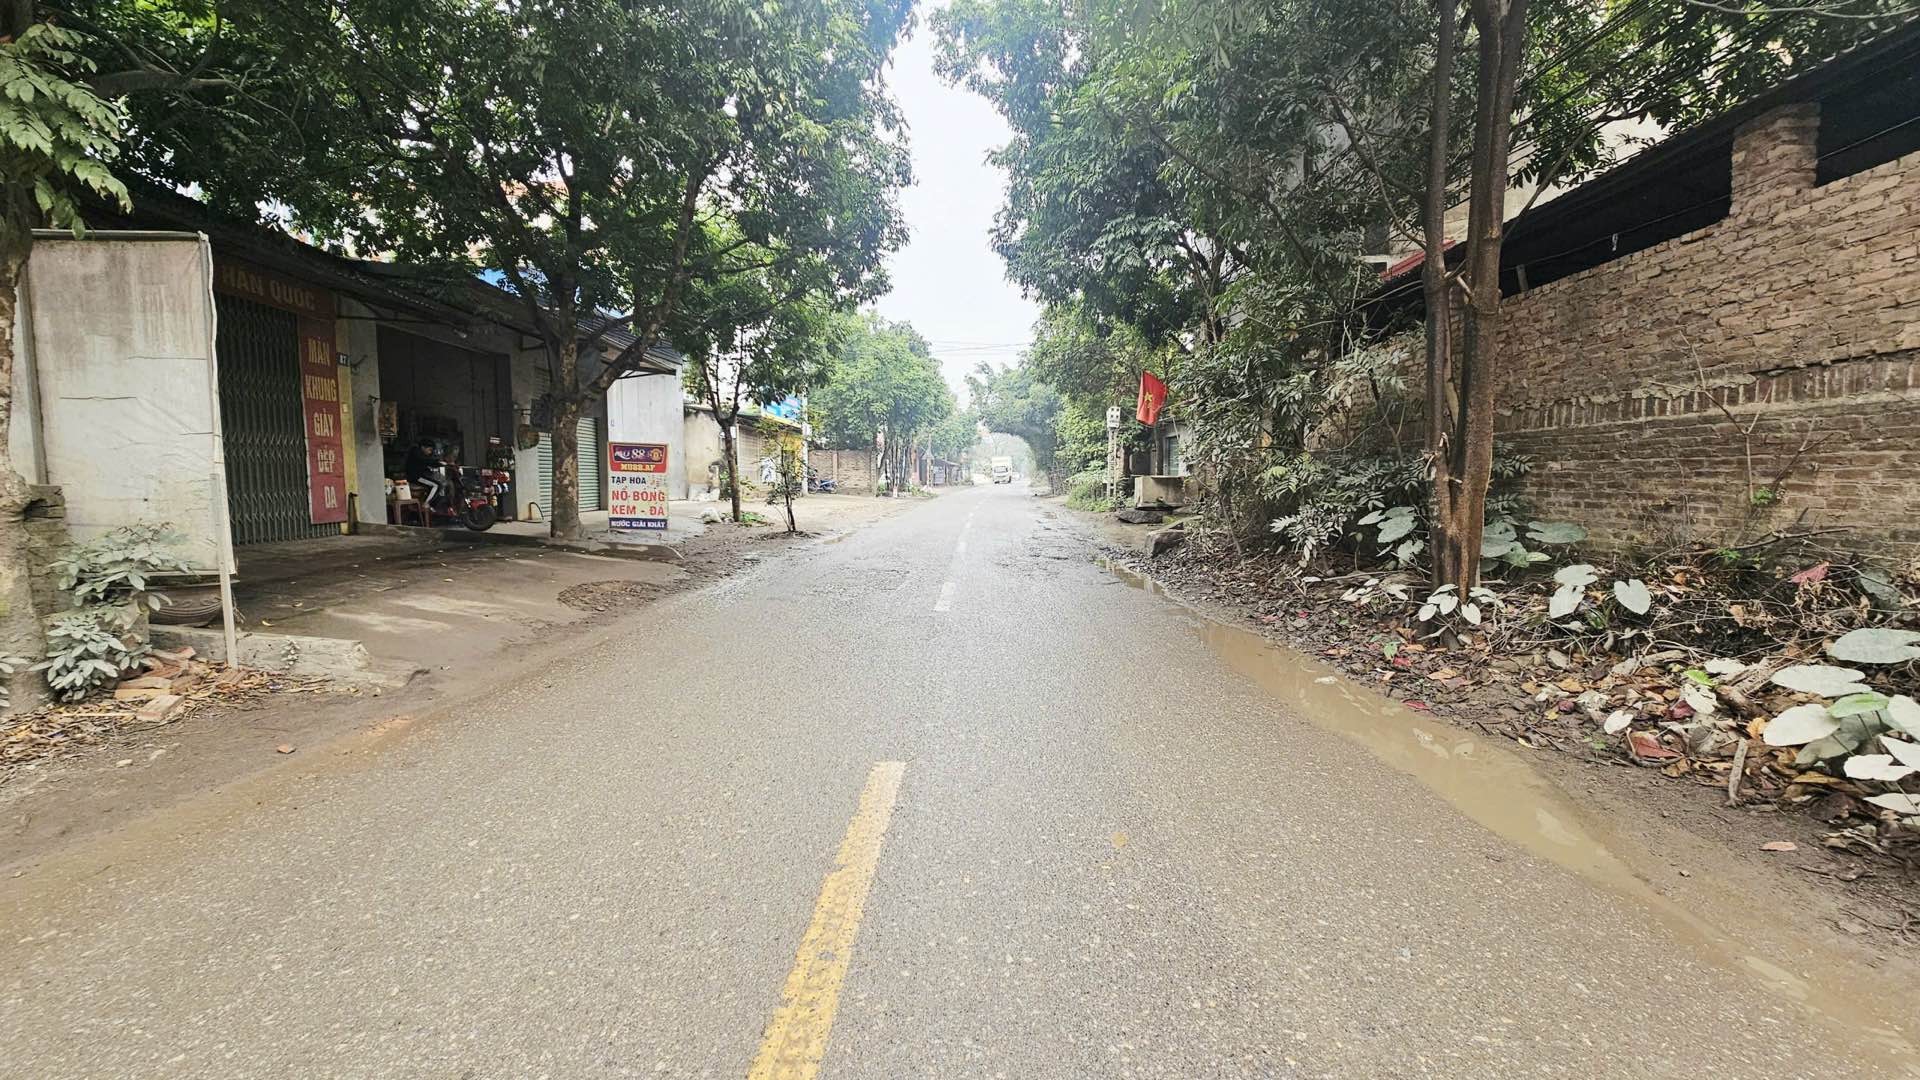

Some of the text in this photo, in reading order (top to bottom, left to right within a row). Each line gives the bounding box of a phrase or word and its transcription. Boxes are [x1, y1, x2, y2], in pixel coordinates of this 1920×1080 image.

[305, 374, 337, 401] KHUNG
[323, 485, 338, 509] DA
[611, 504, 637, 515] KEM
